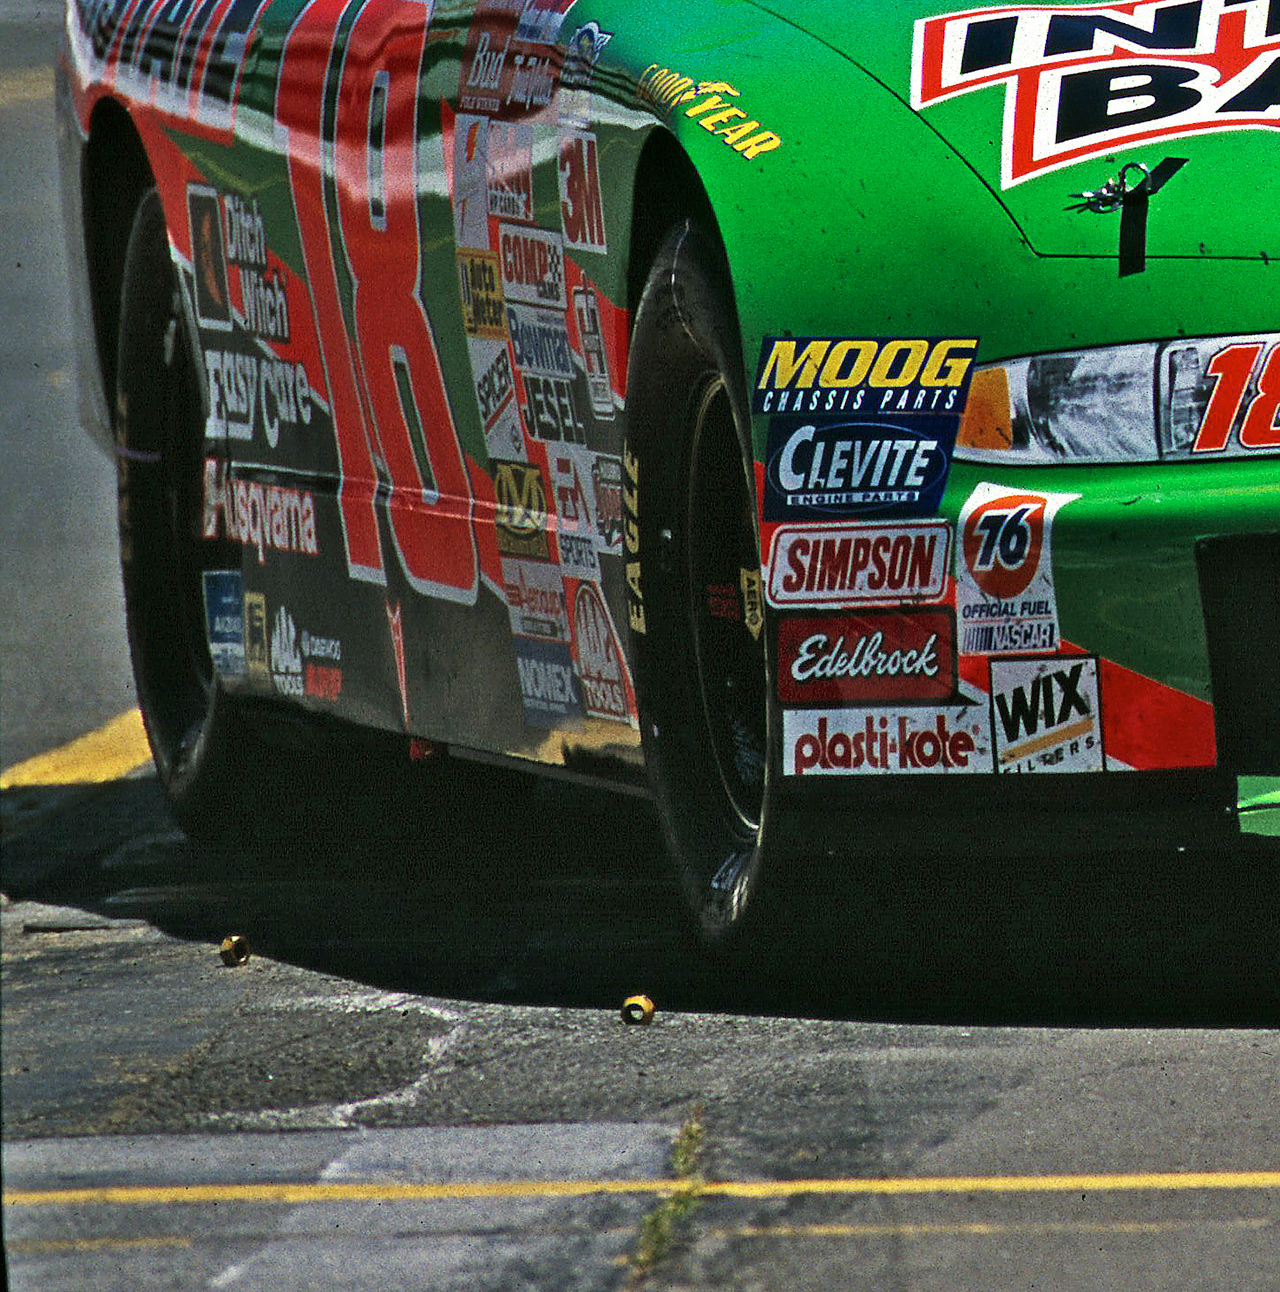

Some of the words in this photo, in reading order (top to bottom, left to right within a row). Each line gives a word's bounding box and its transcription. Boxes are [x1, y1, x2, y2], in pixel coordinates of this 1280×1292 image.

[560, 138, 606, 246] 3M
[223, 193, 267, 266] Ditch
[501, 233, 549, 286] COMP
[239, 266, 290, 343] Witch
[508, 308, 577, 376] Bowman
[757, 338, 977, 390] MOOG
[521, 375, 588, 446] JESEL
[762, 389, 865, 413] CHASSIS
[880, 388, 960, 411] PARTS
[777, 425, 938, 493] CLEVITE
[202, 456, 320, 566] Husqvarna
[622, 439, 647, 636] EAGLE
[974, 506, 1031, 569] 76
[560, 532, 597, 568] SPORTS
[784, 534, 938, 592] SIMPSON
[961, 601, 1018, 619] OFFICIAL
[1020, 600, 1052, 617] FUEL
[516, 656, 579, 704] NOMEX
[790, 633, 939, 682] Edelbrock
[995, 661, 1092, 744] WIX
[794, 714, 976, 775] plasti-kote
